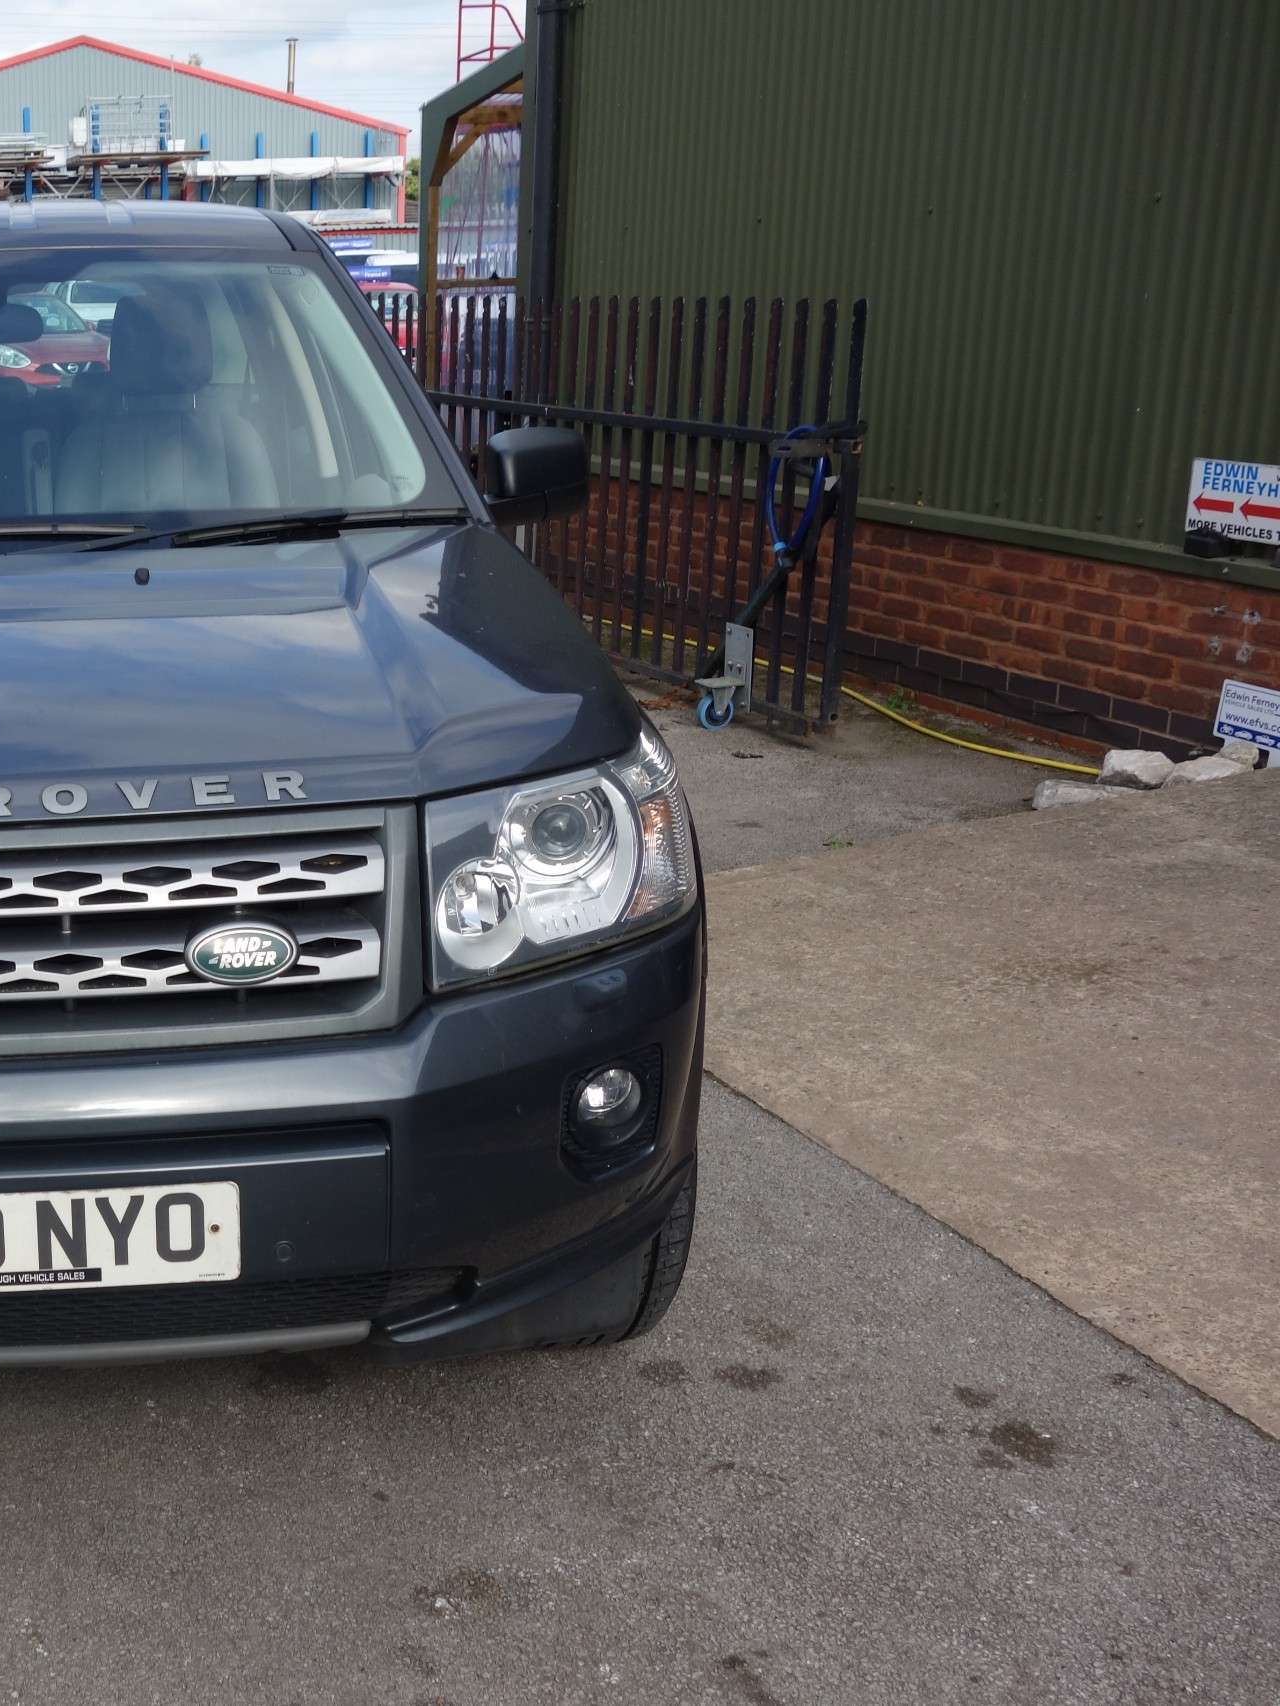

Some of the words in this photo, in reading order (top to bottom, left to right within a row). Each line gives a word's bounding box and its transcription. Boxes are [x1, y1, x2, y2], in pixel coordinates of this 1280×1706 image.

[1203, 461, 1259, 480] EDWIN
[1220, 523, 1273, 540] VEHICLES
[1225, 689, 1250, 702] Edwin
[213, 936, 261, 954] LAND
[219, 951, 277, 969] ROVER
[36, 1192, 205, 1270] NYO
[18, 1272, 55, 1283] VEHICLE
[57, 1271, 86, 1281] SALES
